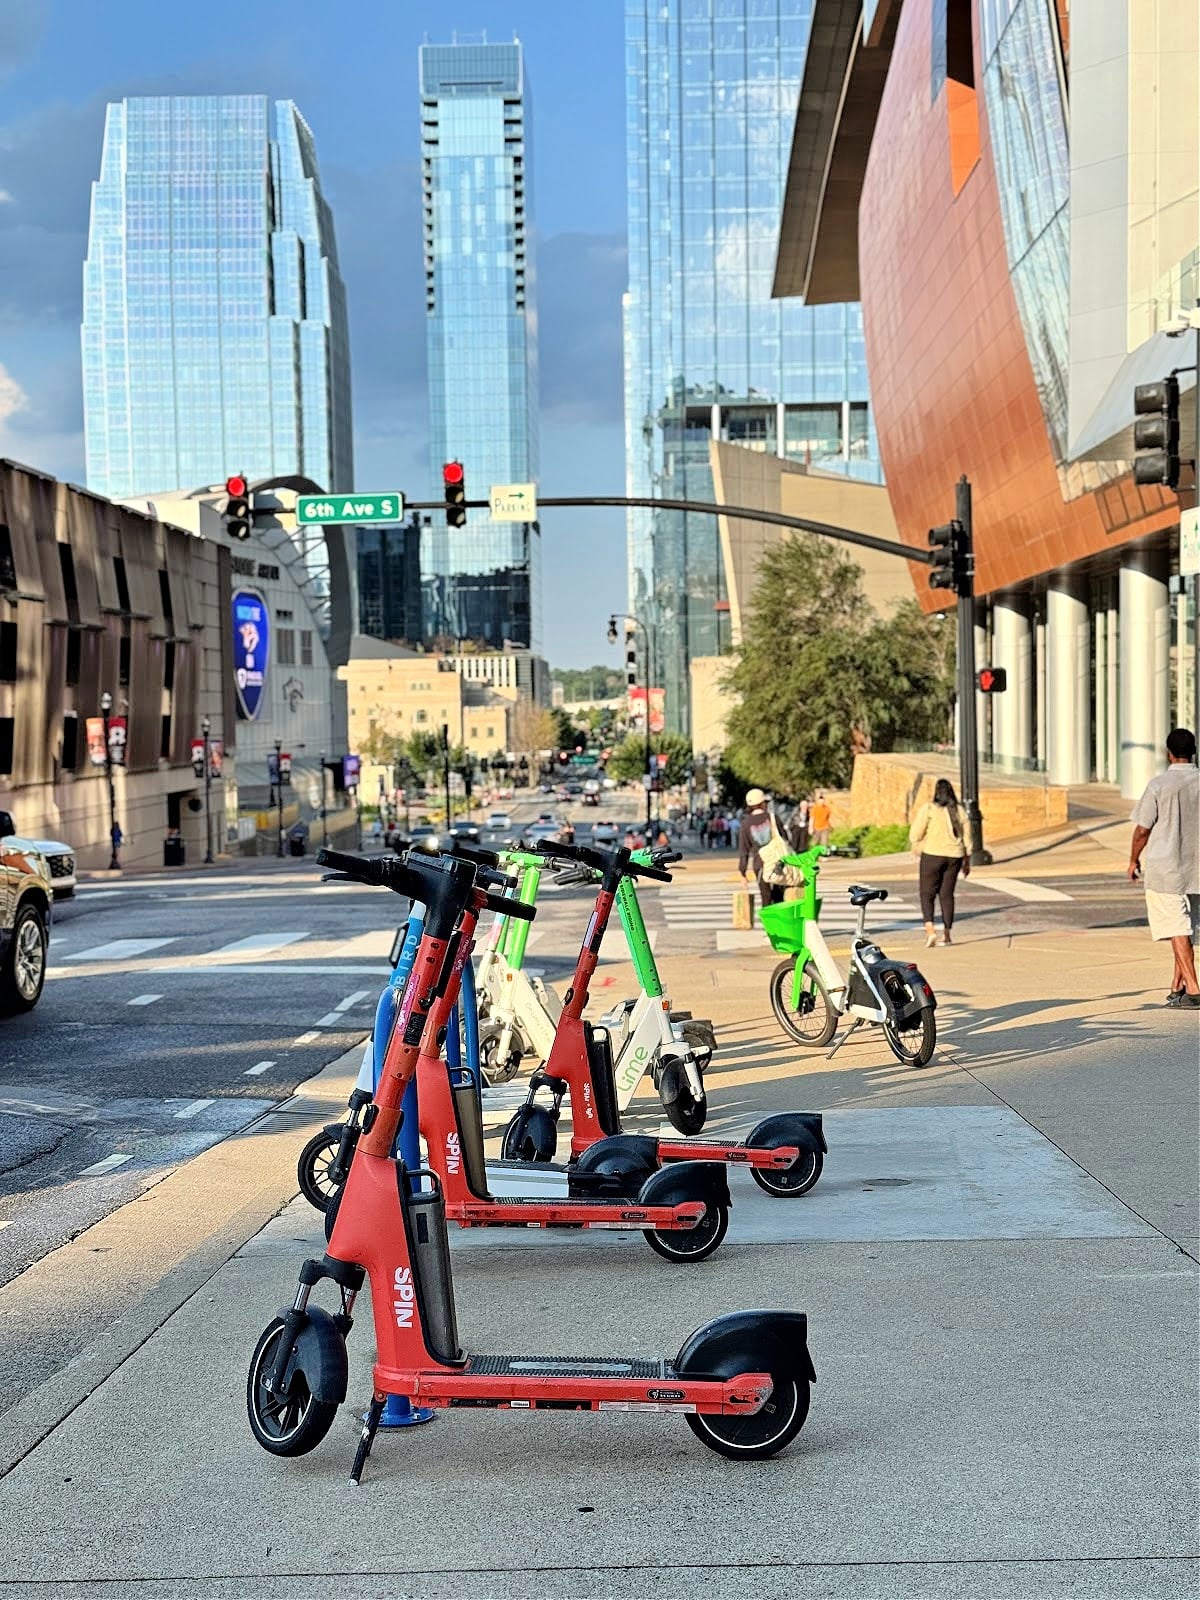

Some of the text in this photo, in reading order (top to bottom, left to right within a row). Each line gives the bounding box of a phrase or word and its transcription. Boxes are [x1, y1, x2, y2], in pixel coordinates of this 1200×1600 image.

[304, 499, 393, 518] 6th Ave S
[394, 934, 418, 986] BIRD
[583, 1082, 591, 1102] SPIN
[446, 1131, 461, 1175] SPIN
[393, 1266, 415, 1328] SPIN
